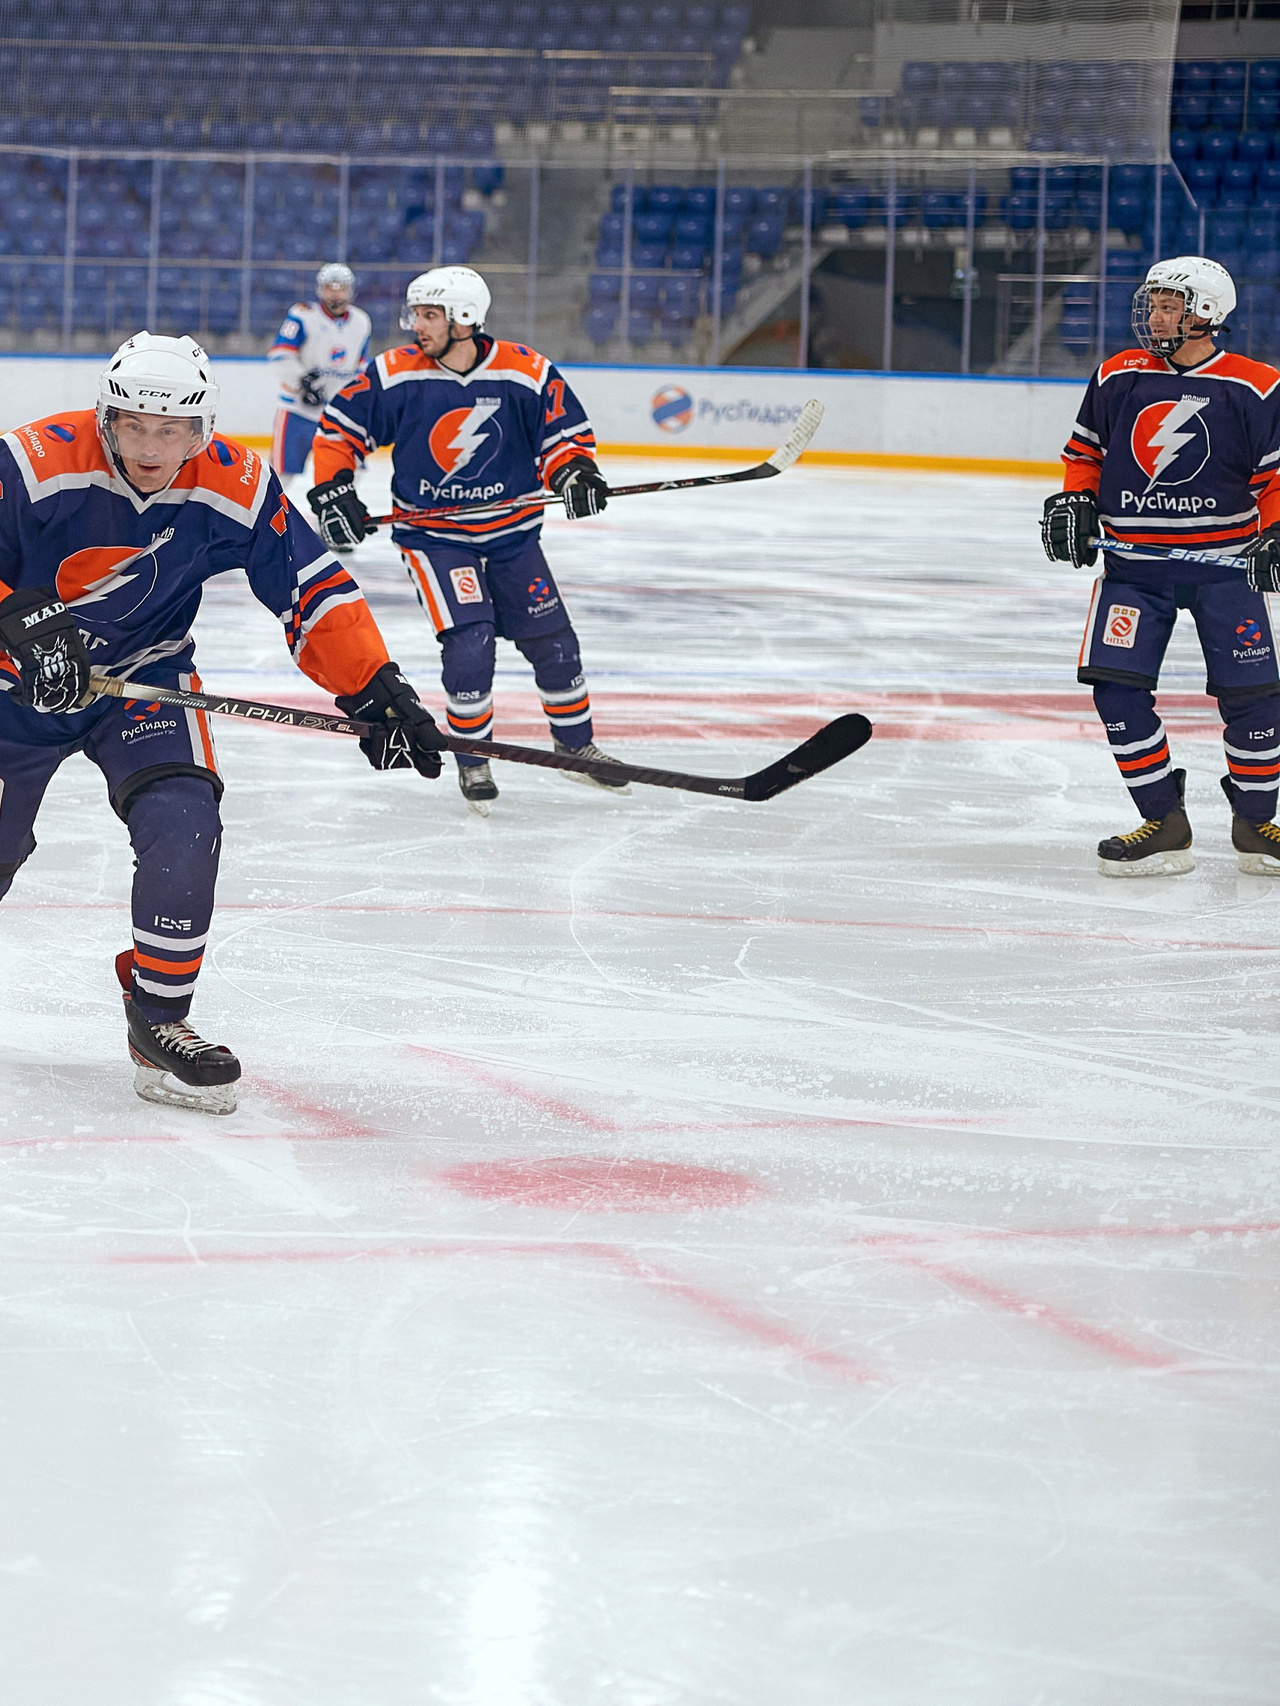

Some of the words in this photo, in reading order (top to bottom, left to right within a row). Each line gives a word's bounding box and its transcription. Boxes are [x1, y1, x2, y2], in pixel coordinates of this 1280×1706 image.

[138, 389, 172, 399] CCM
[420, 479, 504, 501] РусГидро
[1121, 490, 1217, 513] РусГидро
[1232, 646, 1271, 659] РусГидро
[214, 702, 294, 725] ALPHA
[336, 723, 355, 733] SL
[121, 719, 177, 741] РусГидро
